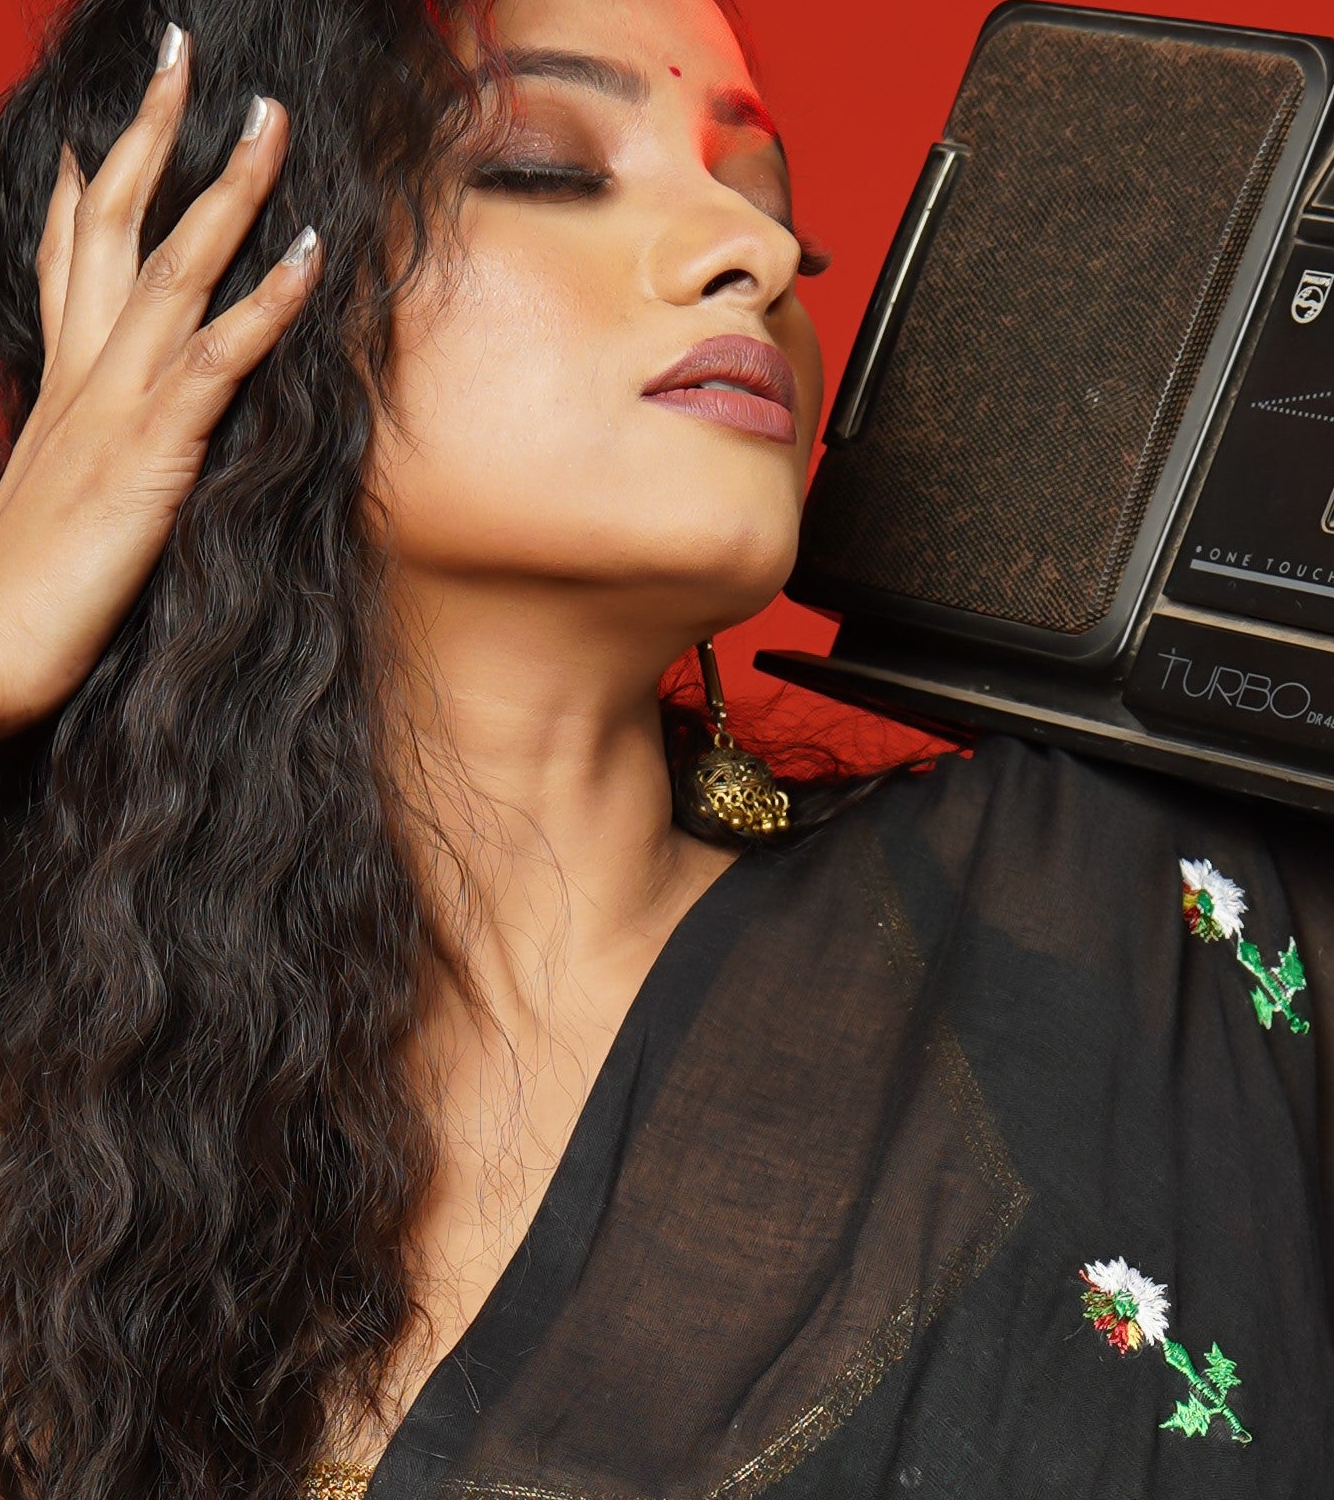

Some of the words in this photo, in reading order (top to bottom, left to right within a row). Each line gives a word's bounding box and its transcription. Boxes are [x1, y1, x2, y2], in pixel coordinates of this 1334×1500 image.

[1209, 548, 1252, 567] ONE
[1158, 648, 1311, 719] TURBO
[1306, 711, 1324, 726] DR
